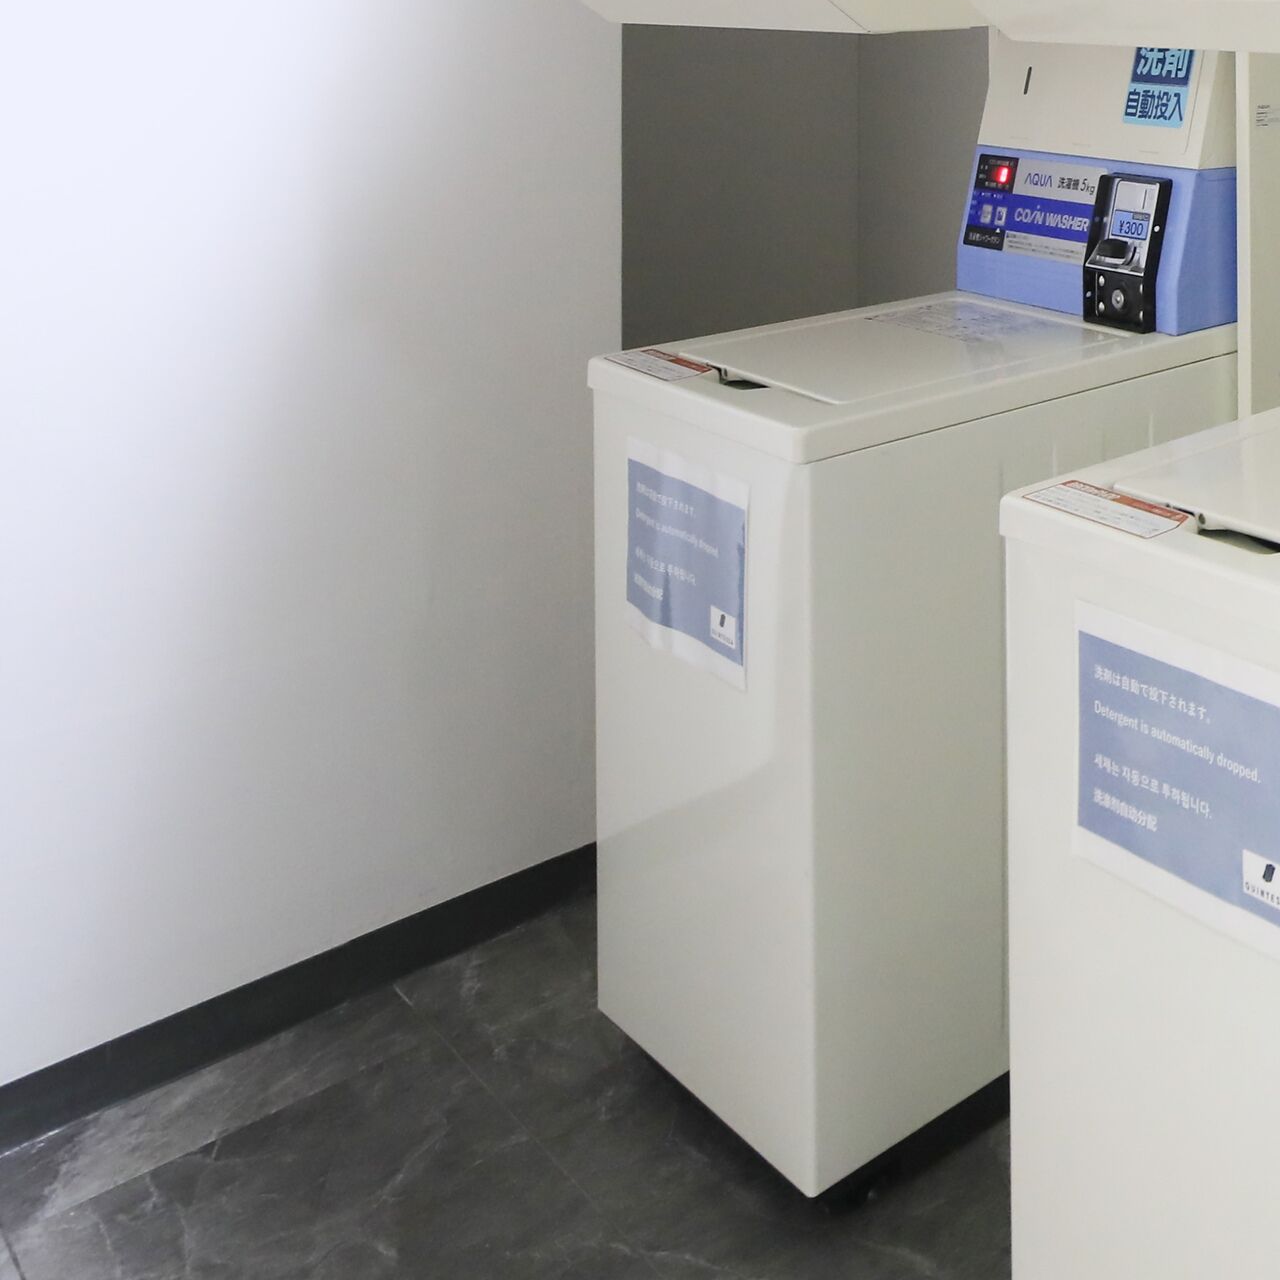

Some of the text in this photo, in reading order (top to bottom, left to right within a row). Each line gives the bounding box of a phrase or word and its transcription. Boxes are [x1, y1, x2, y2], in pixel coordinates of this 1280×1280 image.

[1136, 47, 1190, 80] 洗剤
[1124, 88, 1184, 123] 自動投入
[1024, 173, 1053, 188] AQUA
[1080, 178, 1096, 196] 5kg
[1014, 205, 1090, 232] COIN WASHER
[1119, 219, 1145, 237] ¥300
[1094, 663, 1211, 725] 洗剤は自動で投下されます。
[1094, 699, 1262, 784] Detergent is automatically dropped.
[1121, 766, 1160, 796] 자동으로
